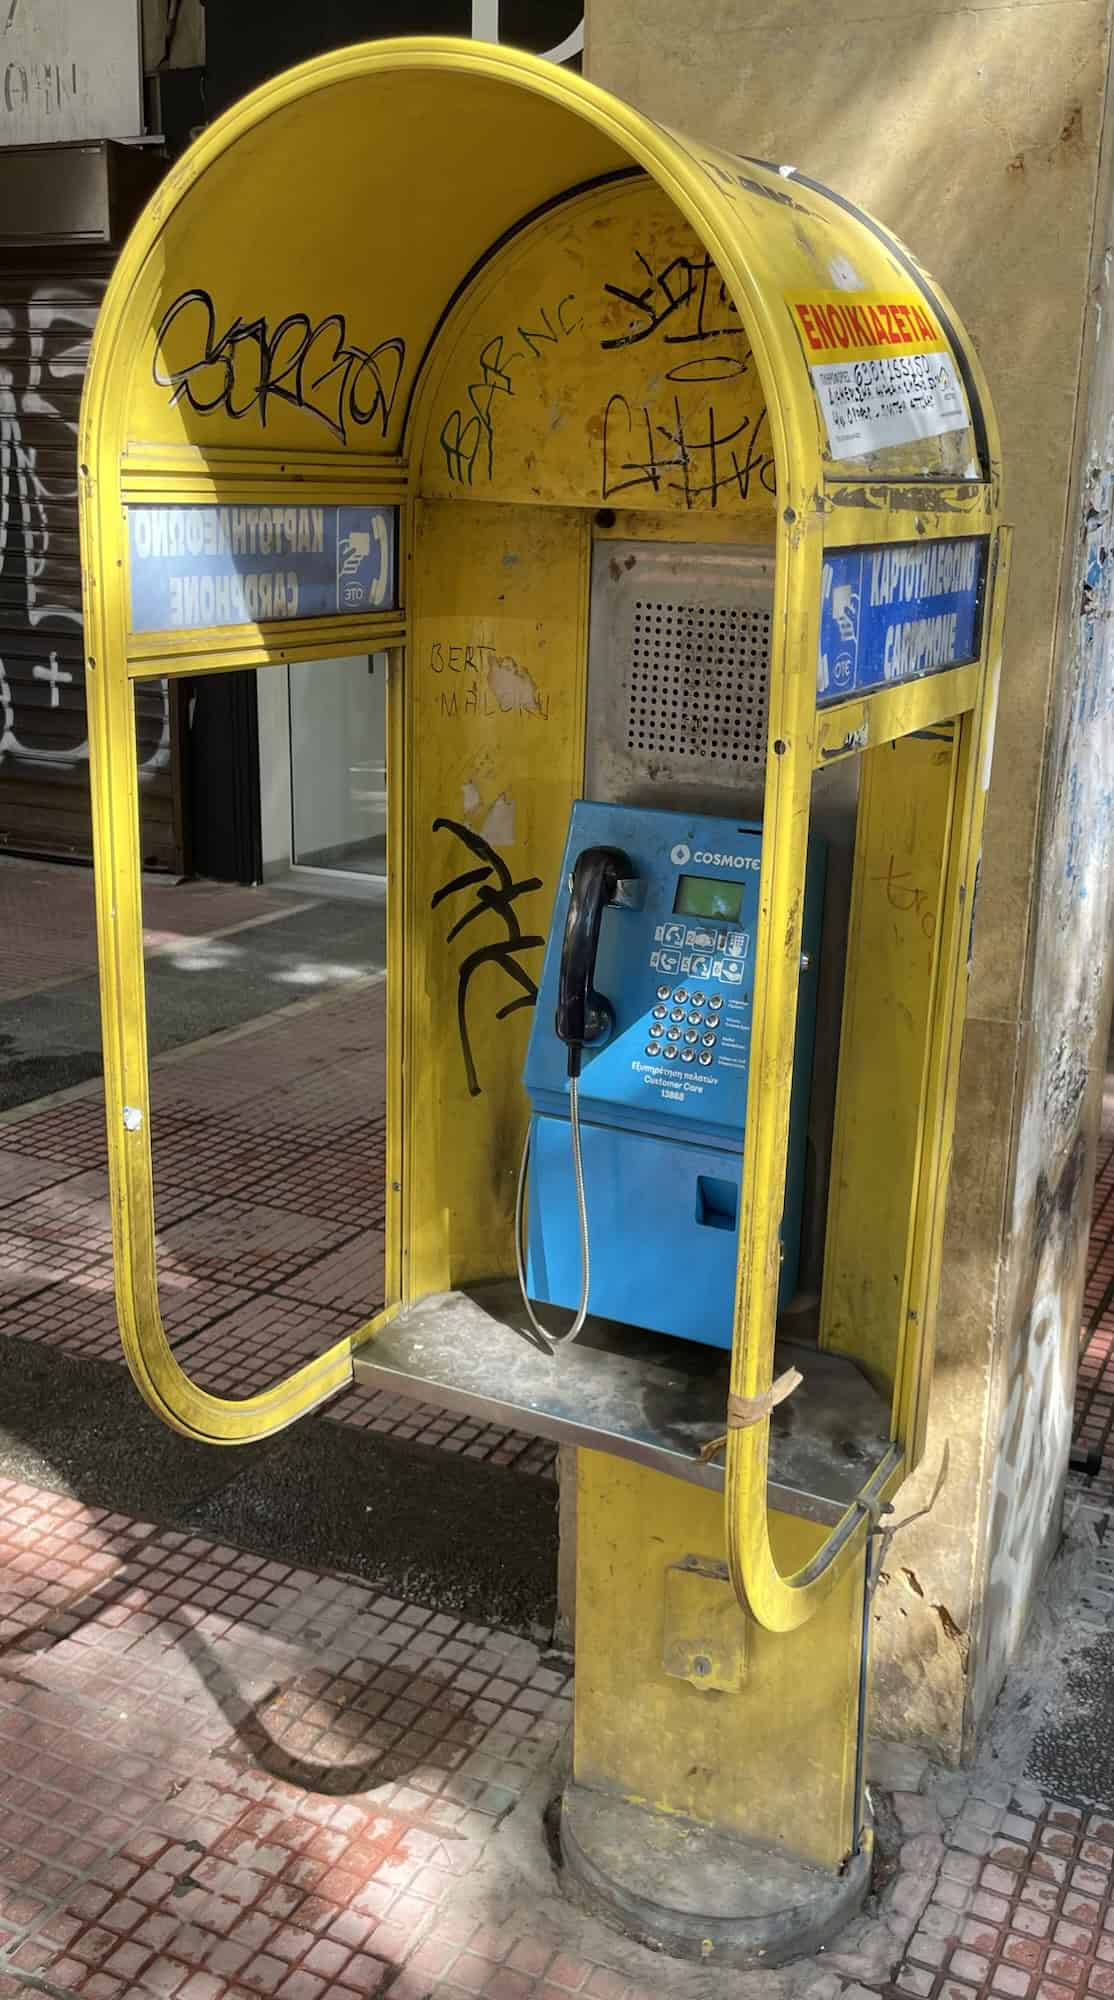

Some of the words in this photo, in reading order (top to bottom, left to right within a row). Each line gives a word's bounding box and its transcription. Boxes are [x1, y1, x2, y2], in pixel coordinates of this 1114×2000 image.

[795, 303, 938, 350] ΕΝΟΙΚΙΑΖΕΤΑΙ
[693, 851, 761, 871] COSMOTE
[644, 1075, 683, 1089] Customer
[683, 1082, 704, 1093] Care
